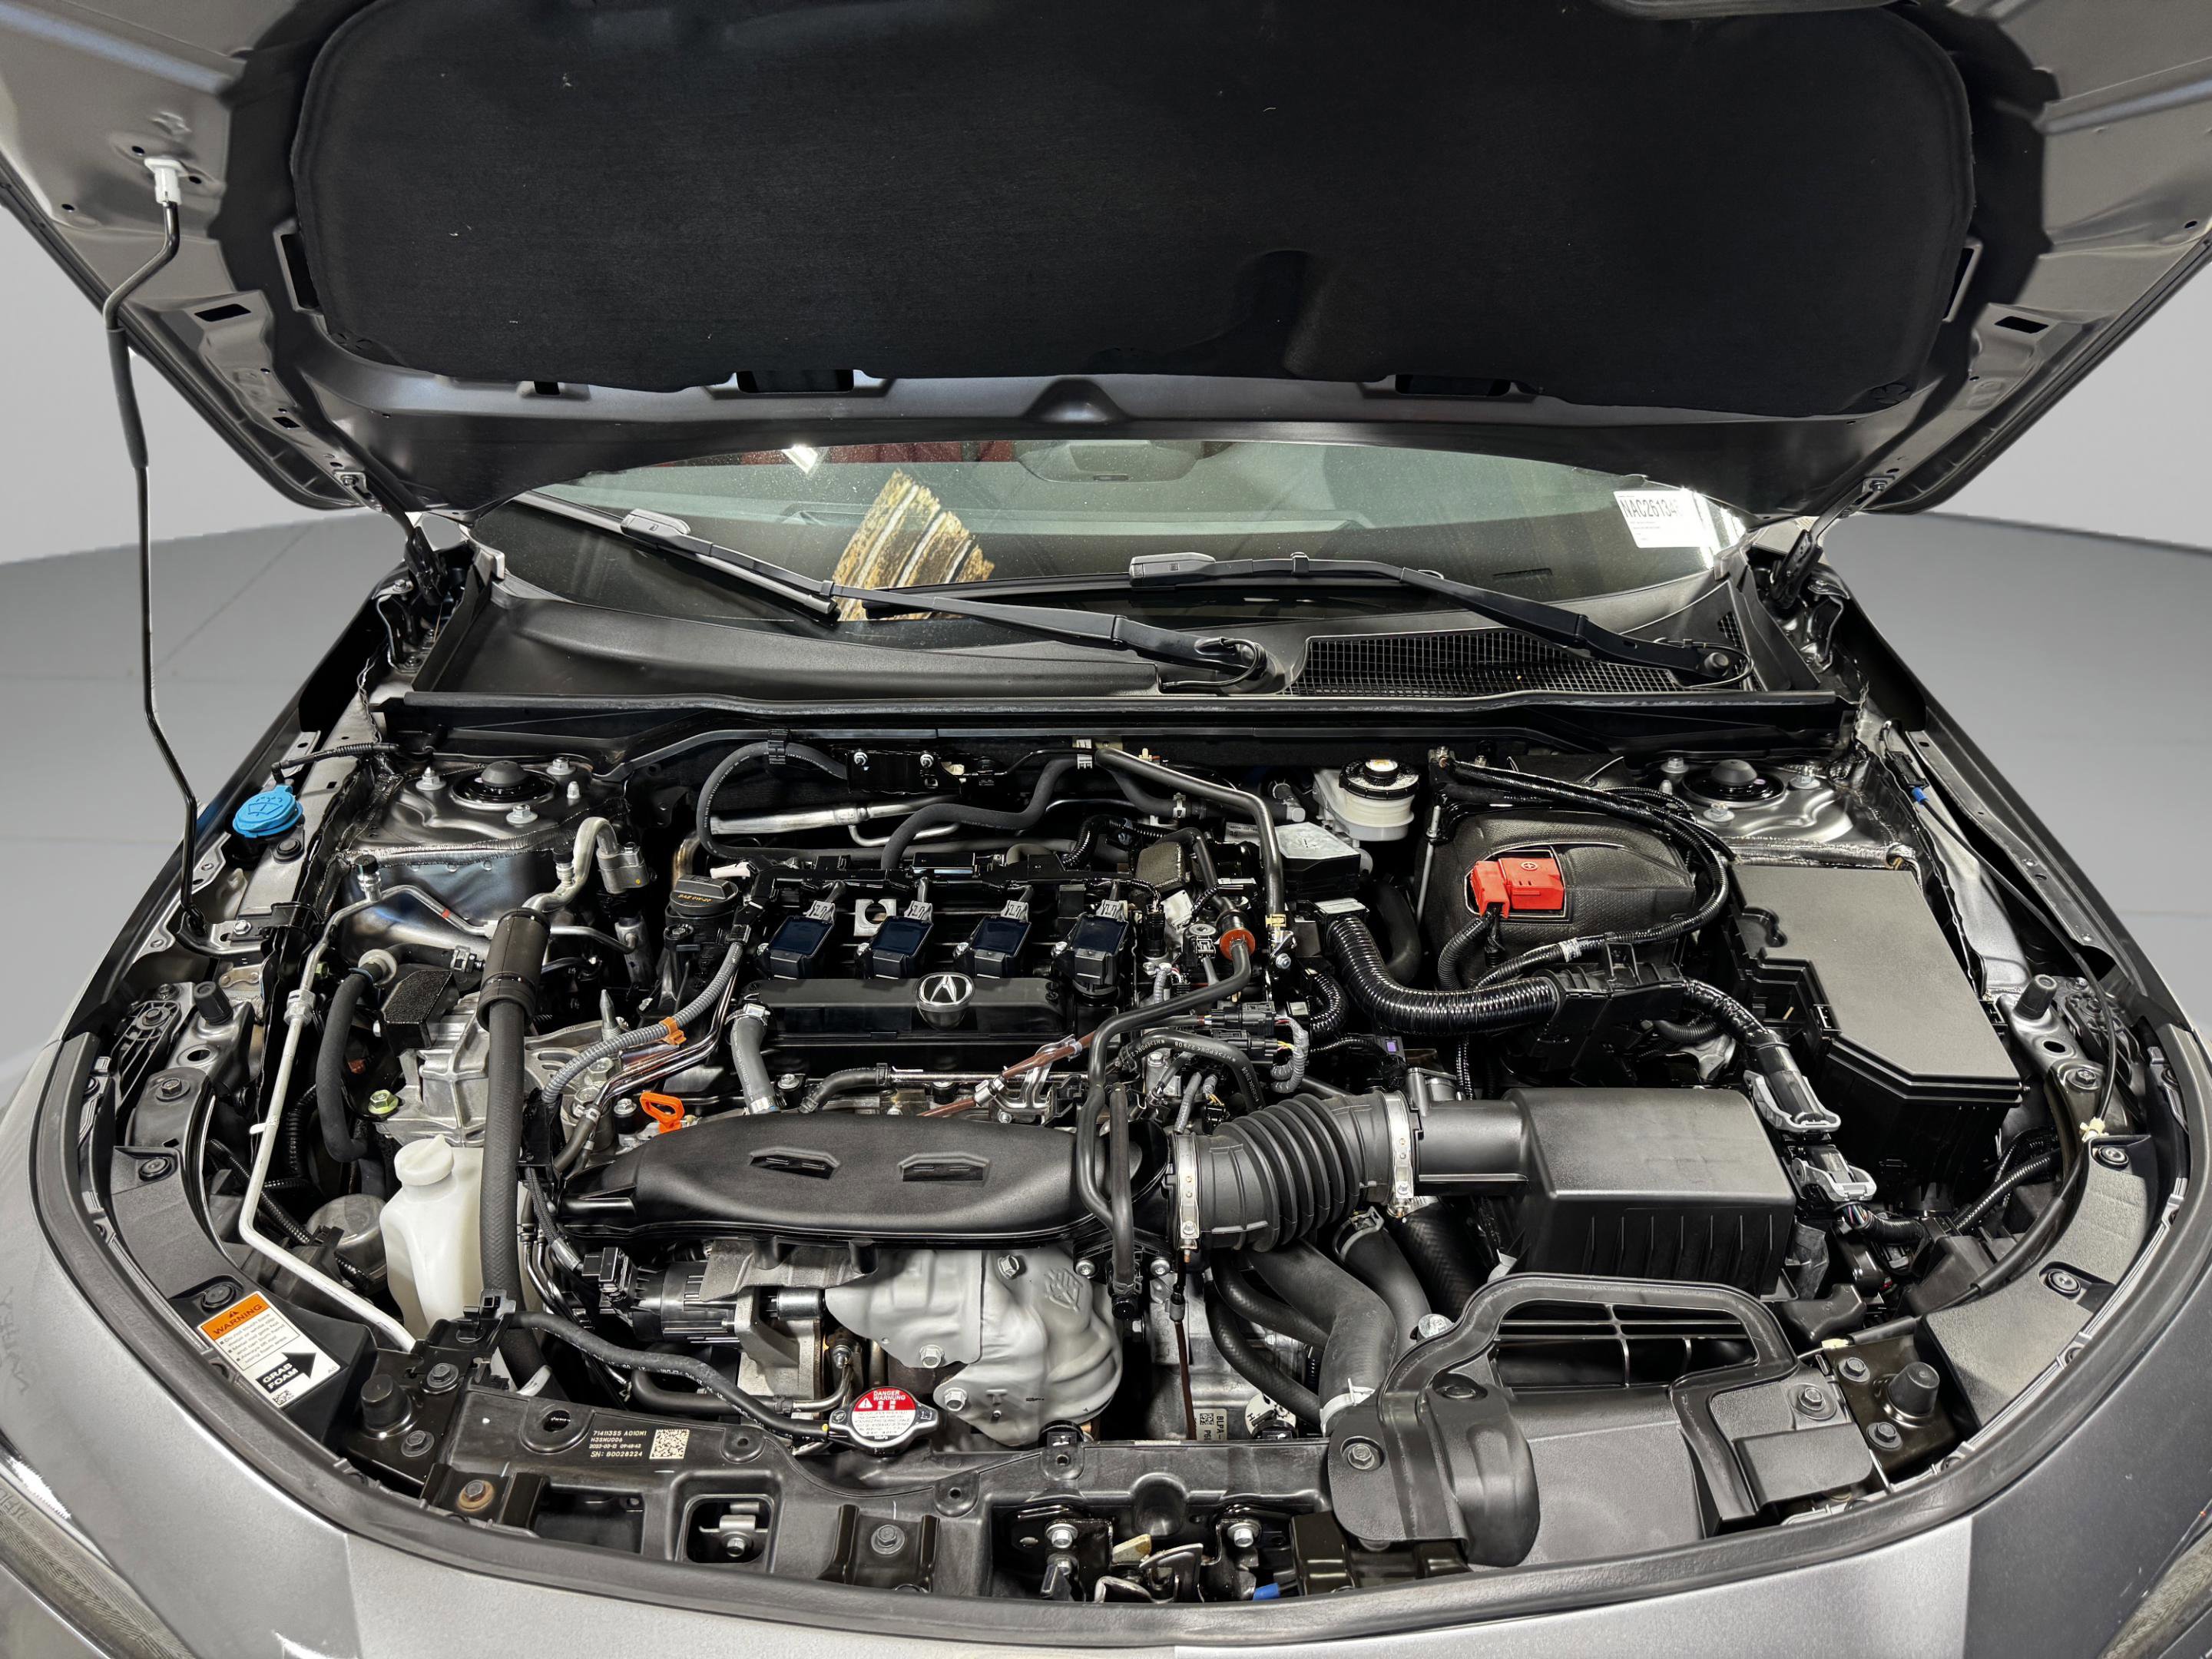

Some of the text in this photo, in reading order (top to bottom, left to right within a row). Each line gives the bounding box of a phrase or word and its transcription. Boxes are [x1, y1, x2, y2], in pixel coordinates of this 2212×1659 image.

[1619, 498, 1683, 518] NAC26134
[213, 1304, 262, 1335] WARNING
[263, 1363, 293, 1382] GRAB
[268, 1368, 299, 1389] FOAM
